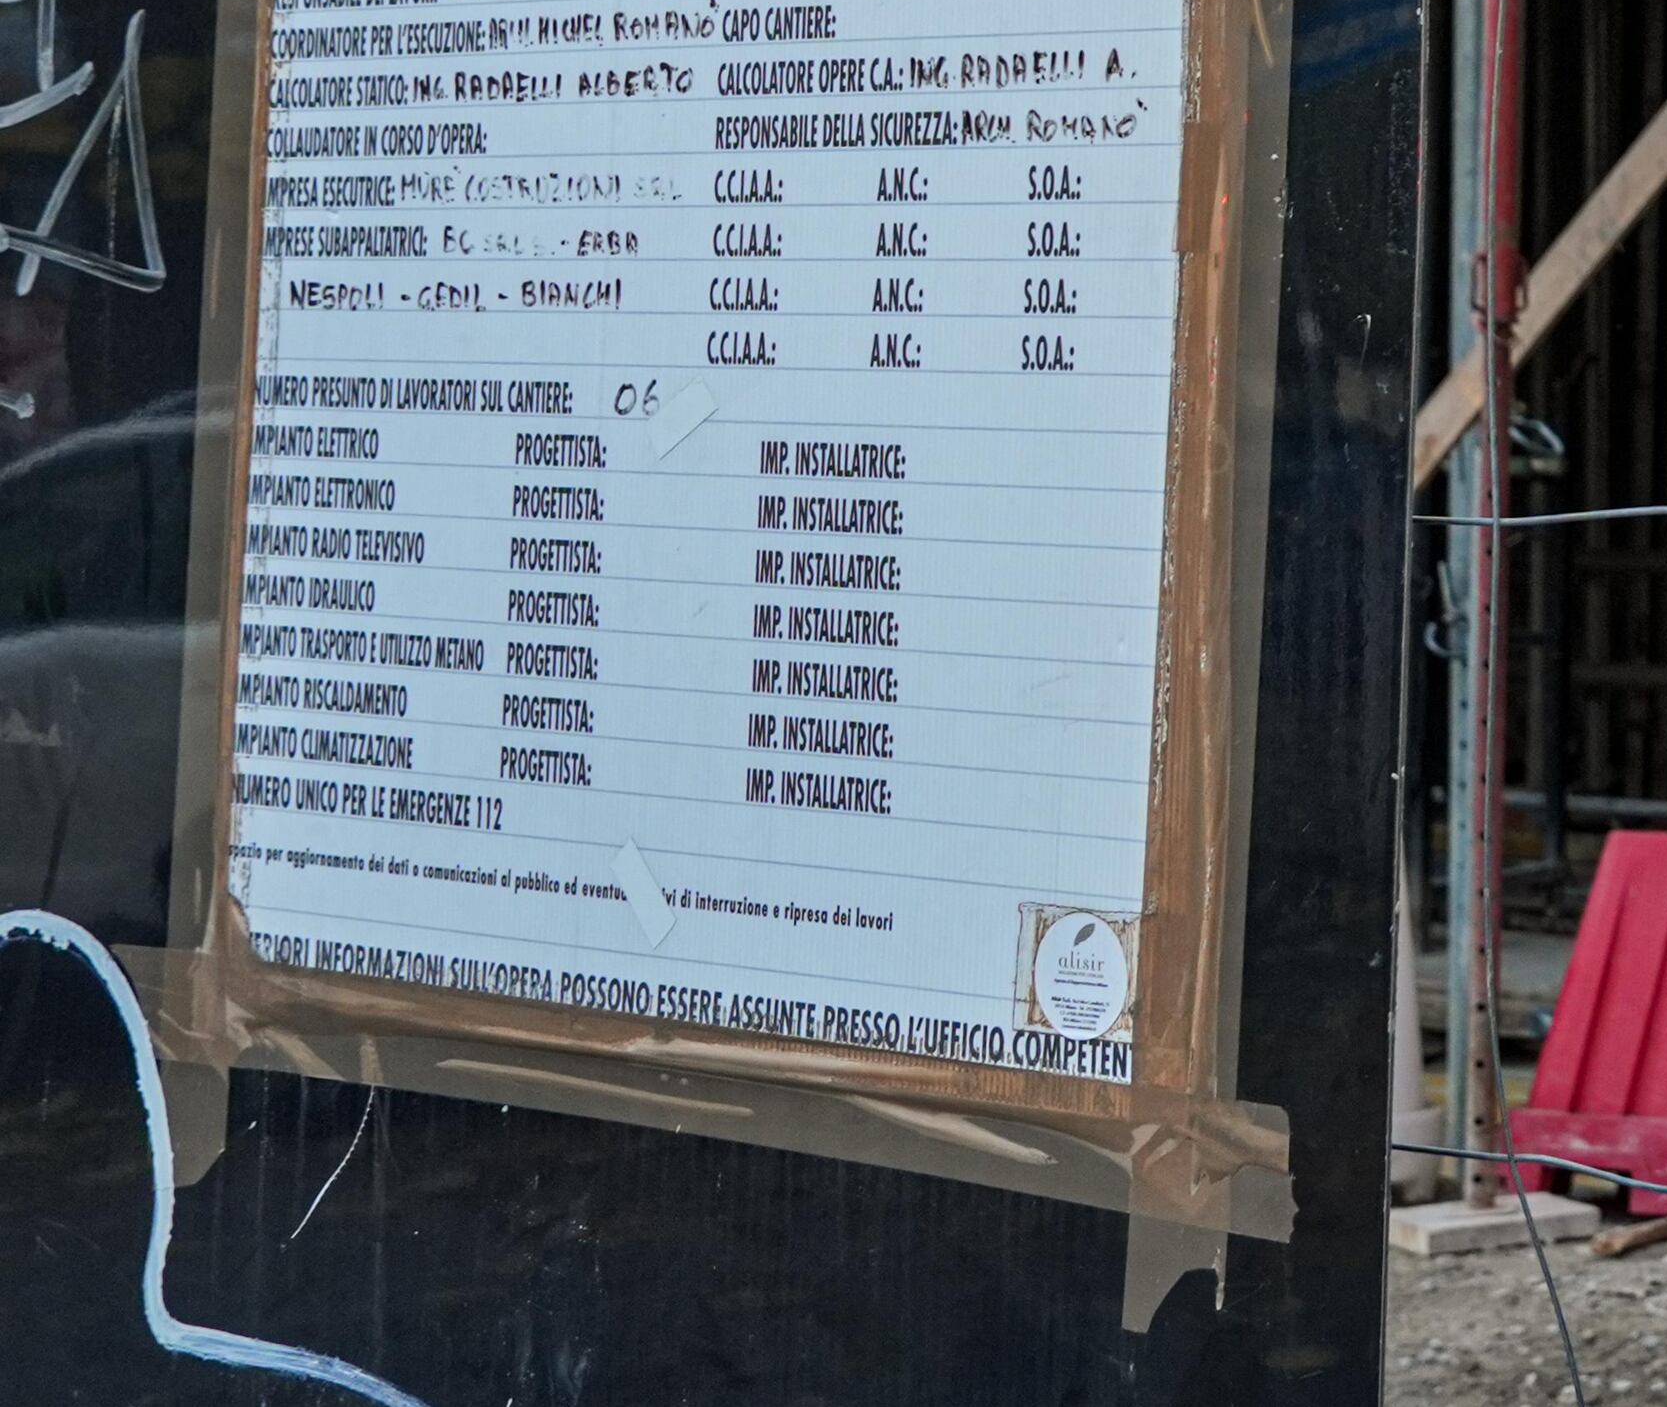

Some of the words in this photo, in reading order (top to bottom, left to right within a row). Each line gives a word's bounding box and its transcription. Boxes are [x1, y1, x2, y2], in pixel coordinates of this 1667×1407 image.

[722, 6, 760, 43] CAPO
[765, 5, 837, 41] CANTIERE:
[718, 59, 814, 96] CALCOLATORE
[818, 58, 865, 93] OPERE
[381, 125, 424, 155] CORSO
[427, 123, 487, 154] D'OPERA:
[716, 114, 818, 150] RESPONSABILE
[822, 112, 865, 148] DELLA
[870, 110, 959, 146] SICUREZZA:
[876, 167, 928, 202] A.N.C.:
[1027, 165, 1081, 201] S.O.A.:
[318, 227, 427, 257] SUBAPPALTATRICI:
[521, 279, 621, 310] BIANCHI
[312, 377, 377, 409] PRESUNTO
[381, 379, 392, 409] DI
[397, 379, 476, 412] LAVORATORI
[480, 381, 503, 413] SUL
[508, 382, 573, 415] CANTIERE:
[614, 380, 660, 417] 06
[317, 427, 379, 459] ELETTRICO
[515, 433, 606, 468] PROGETTISTA:
[760, 440, 790, 476] IMP.
[795, 442, 906, 480] INSTALLATRICE:
[314, 478, 395, 511] ELETTRONICO
[312, 528, 350, 561] RADIO
[355, 530, 425, 564] TELEVISIVO
[309, 578, 375, 612] IDRAULICO
[301, 628, 367, 662] TRASPORTO
[371, 635, 378, 663] E
[380, 635, 431, 668] UTILIZZO
[435, 637, 484, 671] METANO
[303, 683, 407, 717] RISCALDAMENTO
[301, 730, 413, 769] CLIMATIZZAZIONE
[296, 783, 338, 815] UNICO
[342, 787, 367, 817] PER
[371, 789, 385, 818] LE
[390, 791, 470, 827] EMERGENZE
[475, 797, 503, 831] 112
[745, 767, 775, 804] IMP.
[781, 770, 891, 814] INSTALLATRICE:
[265, 848, 283, 866] per
[287, 848, 365, 871] aggiornamento
[368, 856, 385, 873] dei
[388, 856, 409, 876] dati
[413, 864, 419, 877] o
[423, 862, 498, 888] comunicazioni
[501, 868, 511, 888] al
[514, 870, 560, 897] pubblico
[564, 876, 577, 894] ed
[680, 889, 691, 908] di
[695, 891, 768, 918] interruzione
[773, 906, 779, 919] e
[784, 904, 828, 926] ripresa
[834, 905, 851, 927] dei
[855, 907, 893, 931] lavori
[1058, 951, 1104, 972] alisir
[315, 938, 445, 985] INFORMAZIONI
[561, 973, 650, 1014] POSSONO
[658, 984, 721, 1026] ESSERE
[728, 994, 816, 1036] ASSUNTE
[823, 1006, 900, 1047] PRESSO
